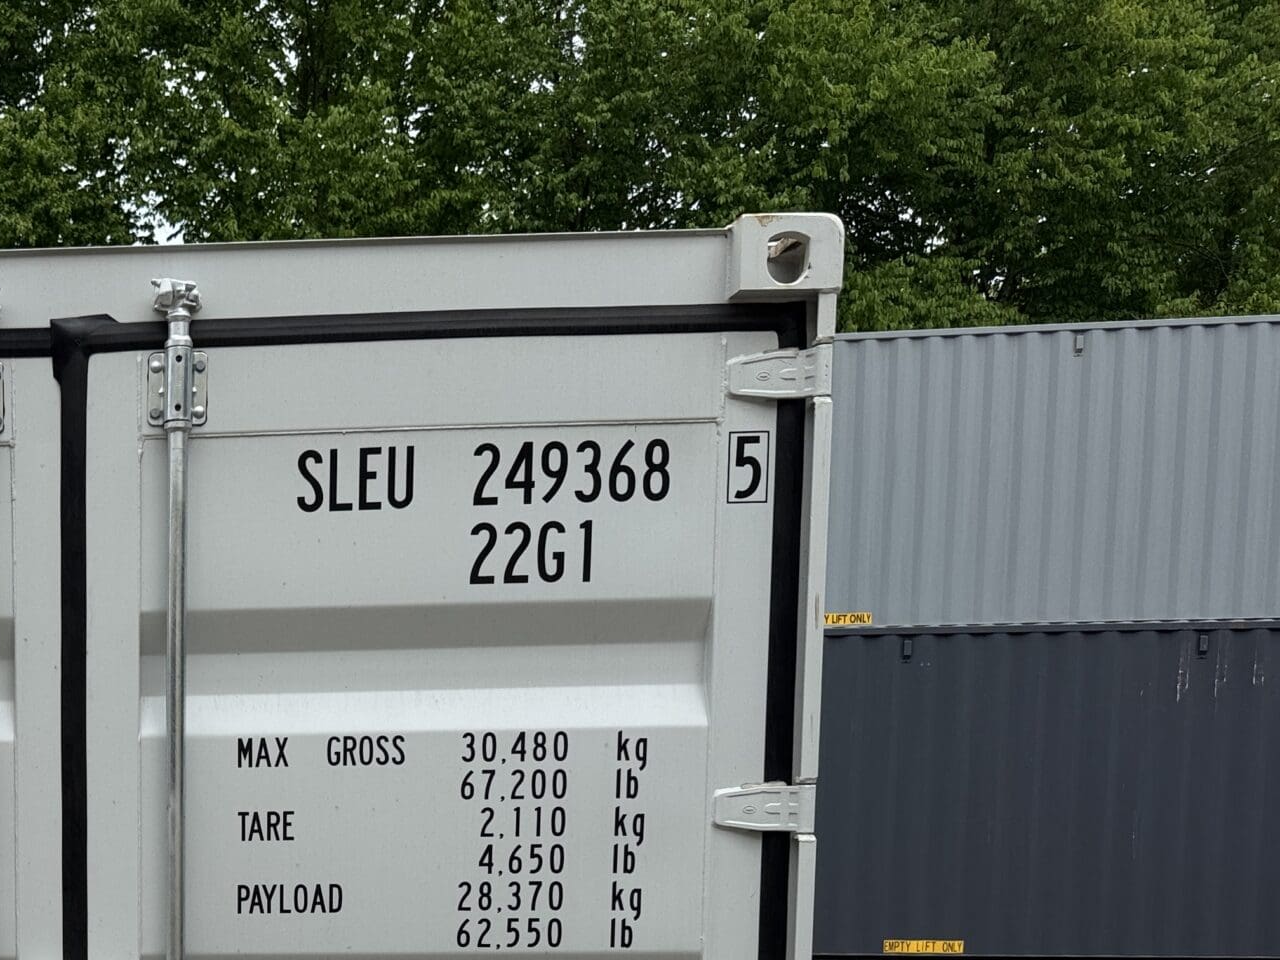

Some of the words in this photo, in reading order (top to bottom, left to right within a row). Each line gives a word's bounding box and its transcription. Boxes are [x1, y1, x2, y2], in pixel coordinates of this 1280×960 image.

[297, 446, 414, 512] SLEU
[473, 439, 669, 505] 249368
[735, 436, 761, 498] 5
[470, 520, 592, 584] 22G1
[832, 615, 847, 624] LIFT
[850, 614, 871, 624] ONLY
[238, 737, 288, 768] MAX
[327, 735, 405, 766] GROSS
[462, 731, 568, 764] 30,480
[617, 731, 648, 770] kg
[461, 769, 567, 801] 67,200
[616, 769, 639, 799] lb
[238, 811, 294, 841] TARE
[481, 807, 565, 838] 2,110
[614, 806, 645, 845] kg
[479, 844, 564, 876] 4,650
[613, 844, 636, 873] lb
[238, 884, 342, 914] PAYLOAD
[458, 881, 563, 913] 28,370
[611, 881, 642, 920] kg
[457, 918, 562, 949] 62,550
[611, 918, 634, 948] lb
[884, 941, 911, 952] EMPTY
[916, 941, 936, 952] LIFT
[942, 941, 963, 952] ONLY
